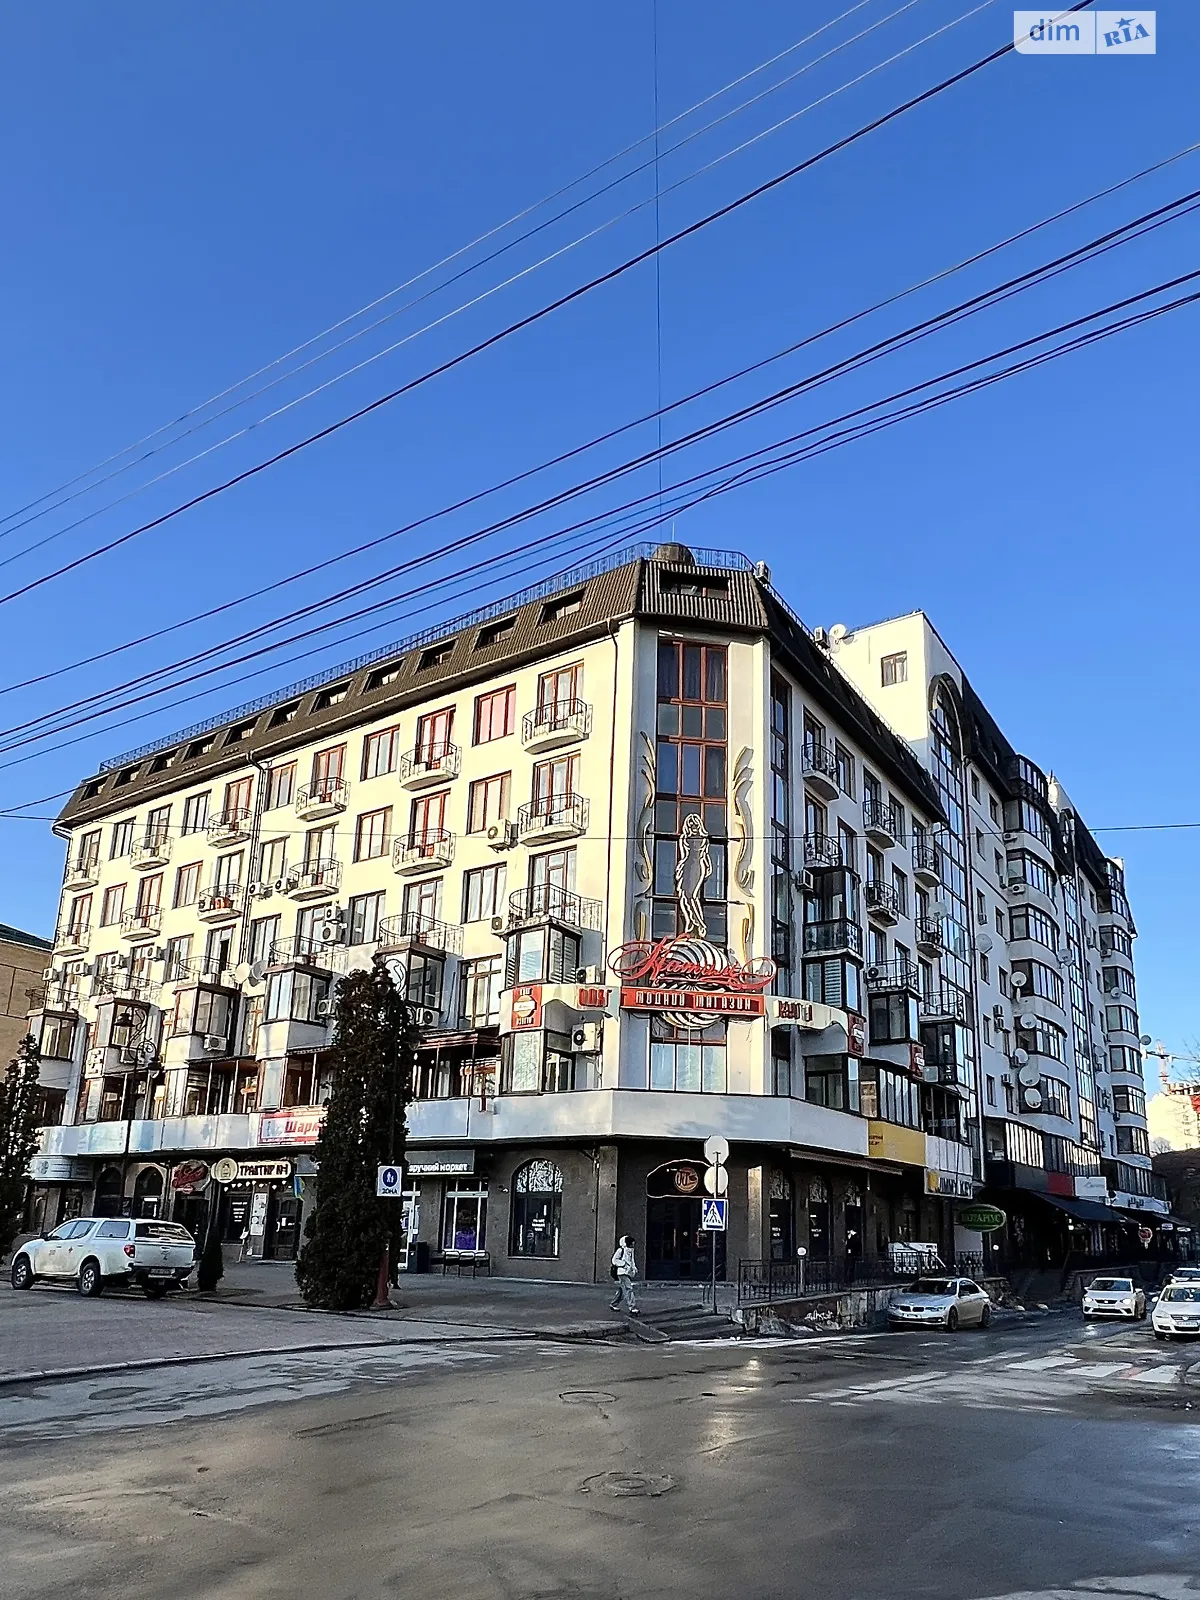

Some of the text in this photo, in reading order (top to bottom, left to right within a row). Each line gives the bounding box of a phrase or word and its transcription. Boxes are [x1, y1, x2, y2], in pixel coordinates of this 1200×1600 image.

[695, 993, 752, 1011] МАГАЗИН
[239, 1164, 276, 1176] ТРАКТИР
[381, 1187, 399, 1195] ЗОНА
